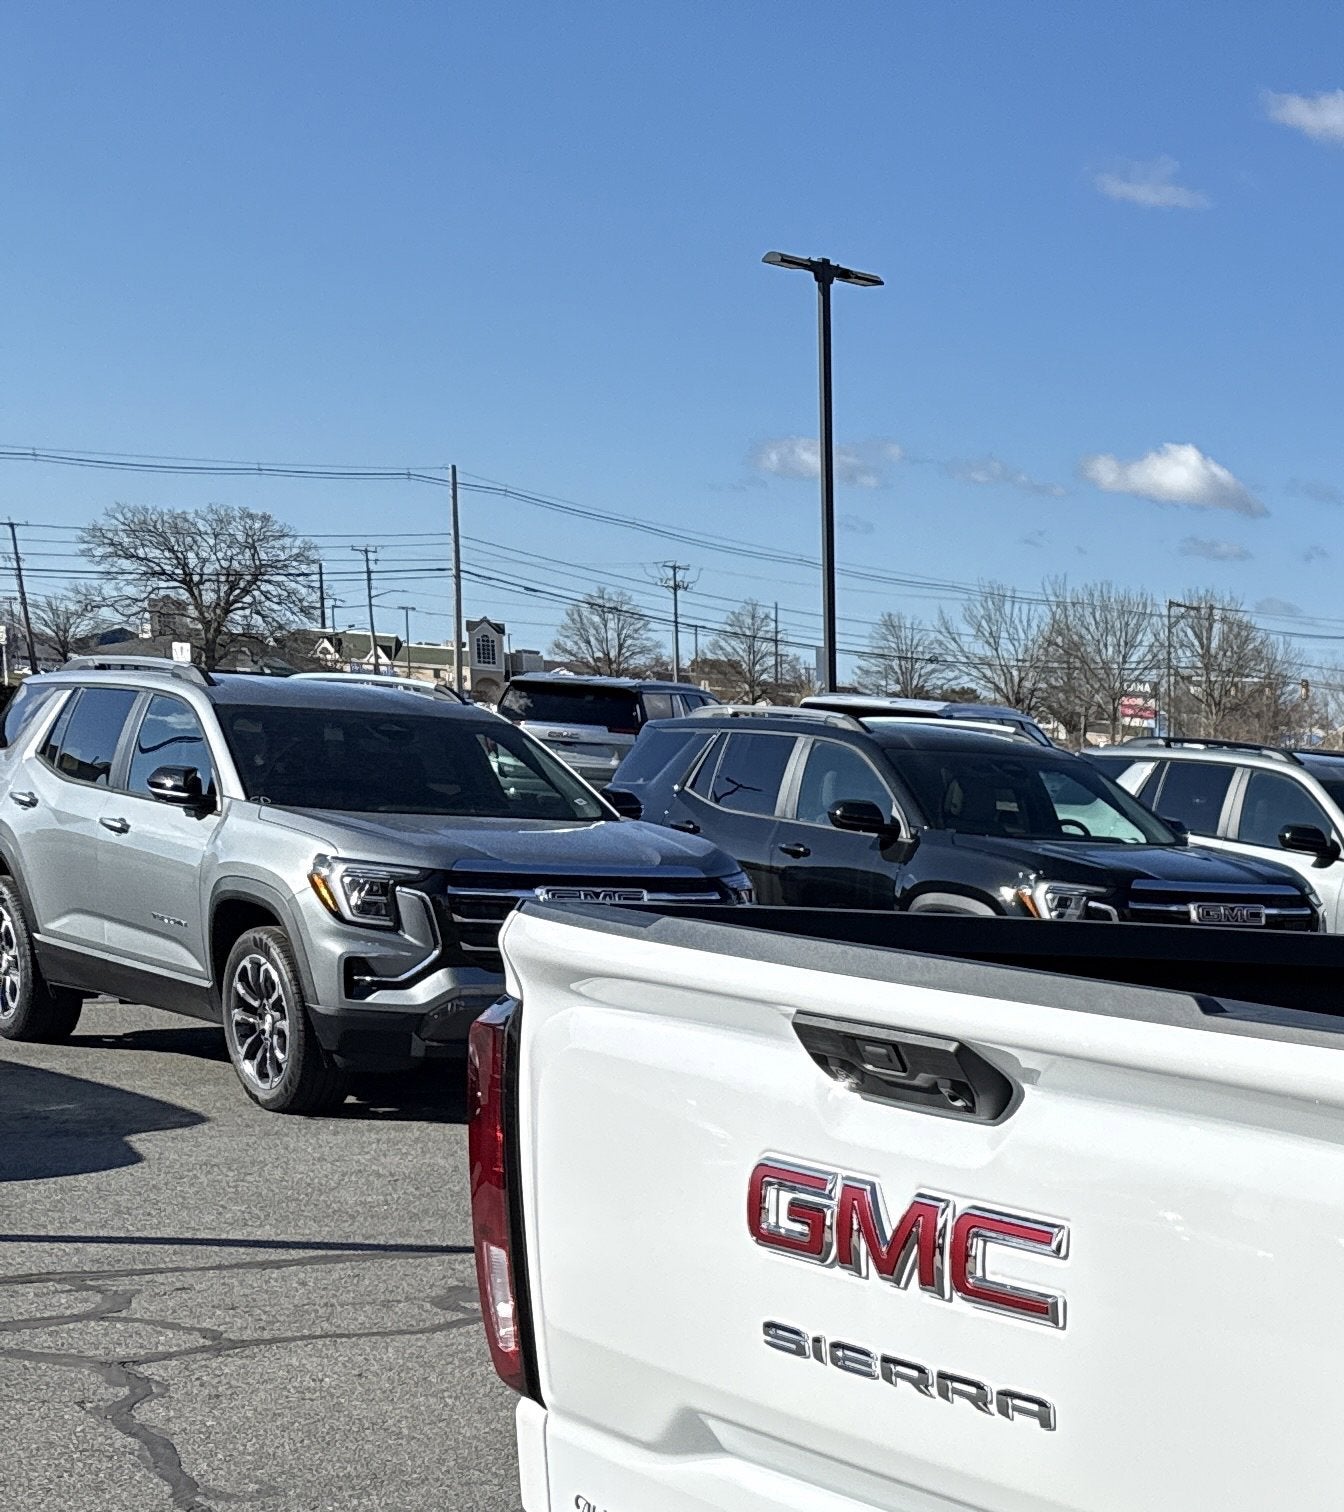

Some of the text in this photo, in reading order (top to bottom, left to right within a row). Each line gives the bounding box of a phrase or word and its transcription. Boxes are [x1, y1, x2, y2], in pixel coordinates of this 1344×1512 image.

[1199, 905, 1263, 923] GMC
[747, 1156, 1070, 1330] GMC
[763, 1319, 1057, 1431] SIERRA
